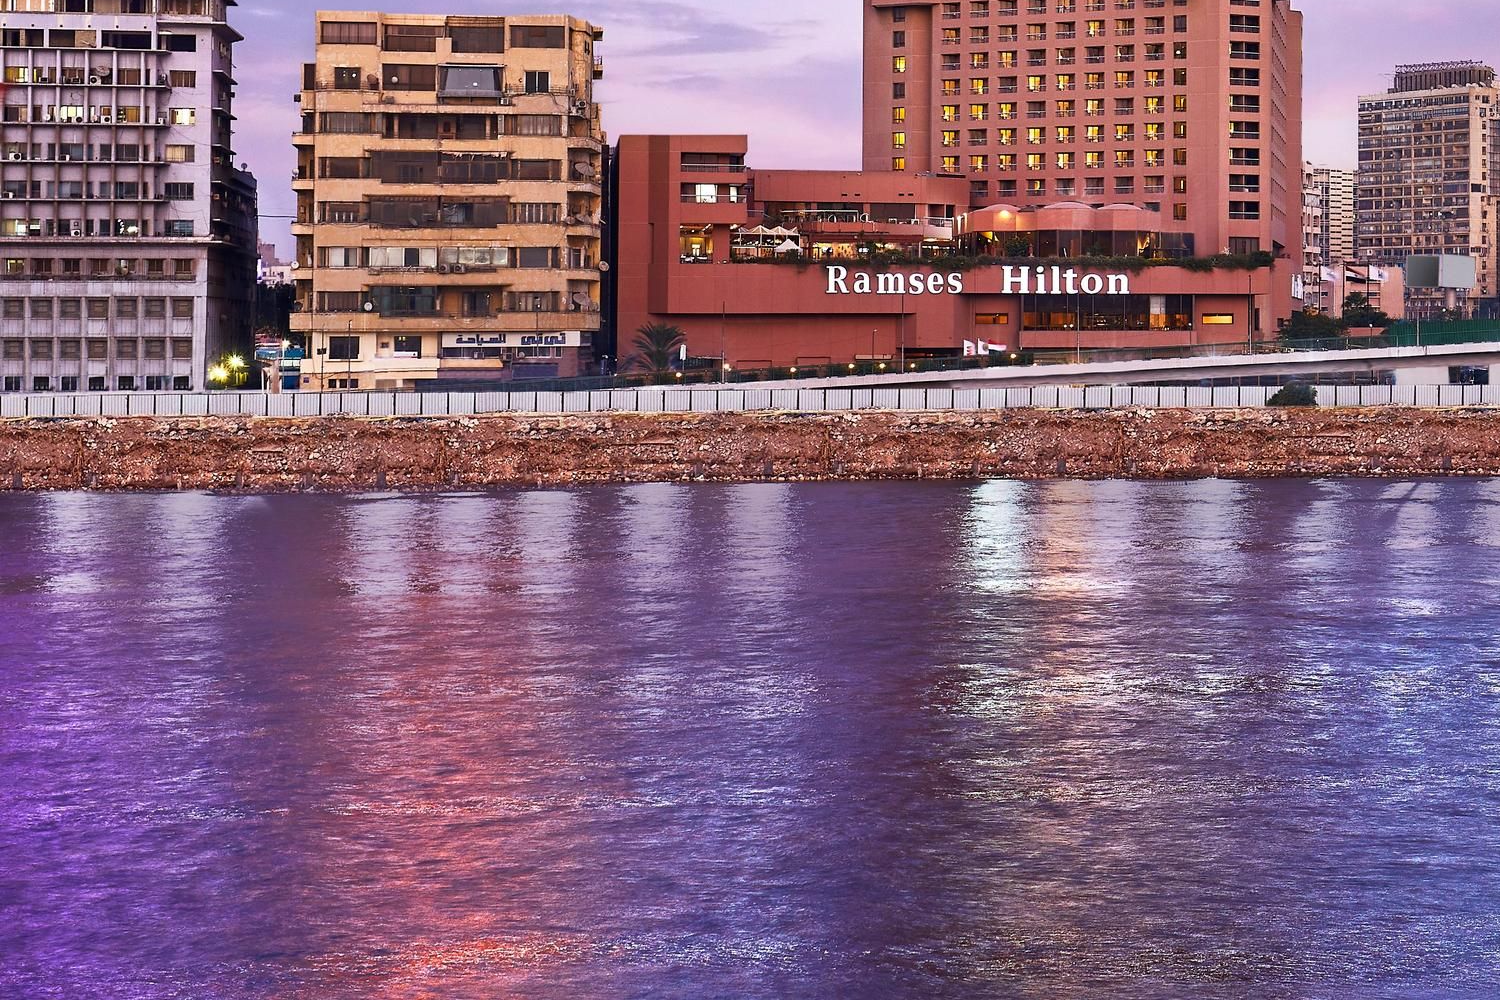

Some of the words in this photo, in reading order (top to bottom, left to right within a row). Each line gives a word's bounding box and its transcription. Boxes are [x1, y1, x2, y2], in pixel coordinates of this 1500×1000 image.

[825, 264, 964, 295] Ramses
[1001, 264, 1131, 295] Hilton
[456, 333, 507, 346] للسياحة
